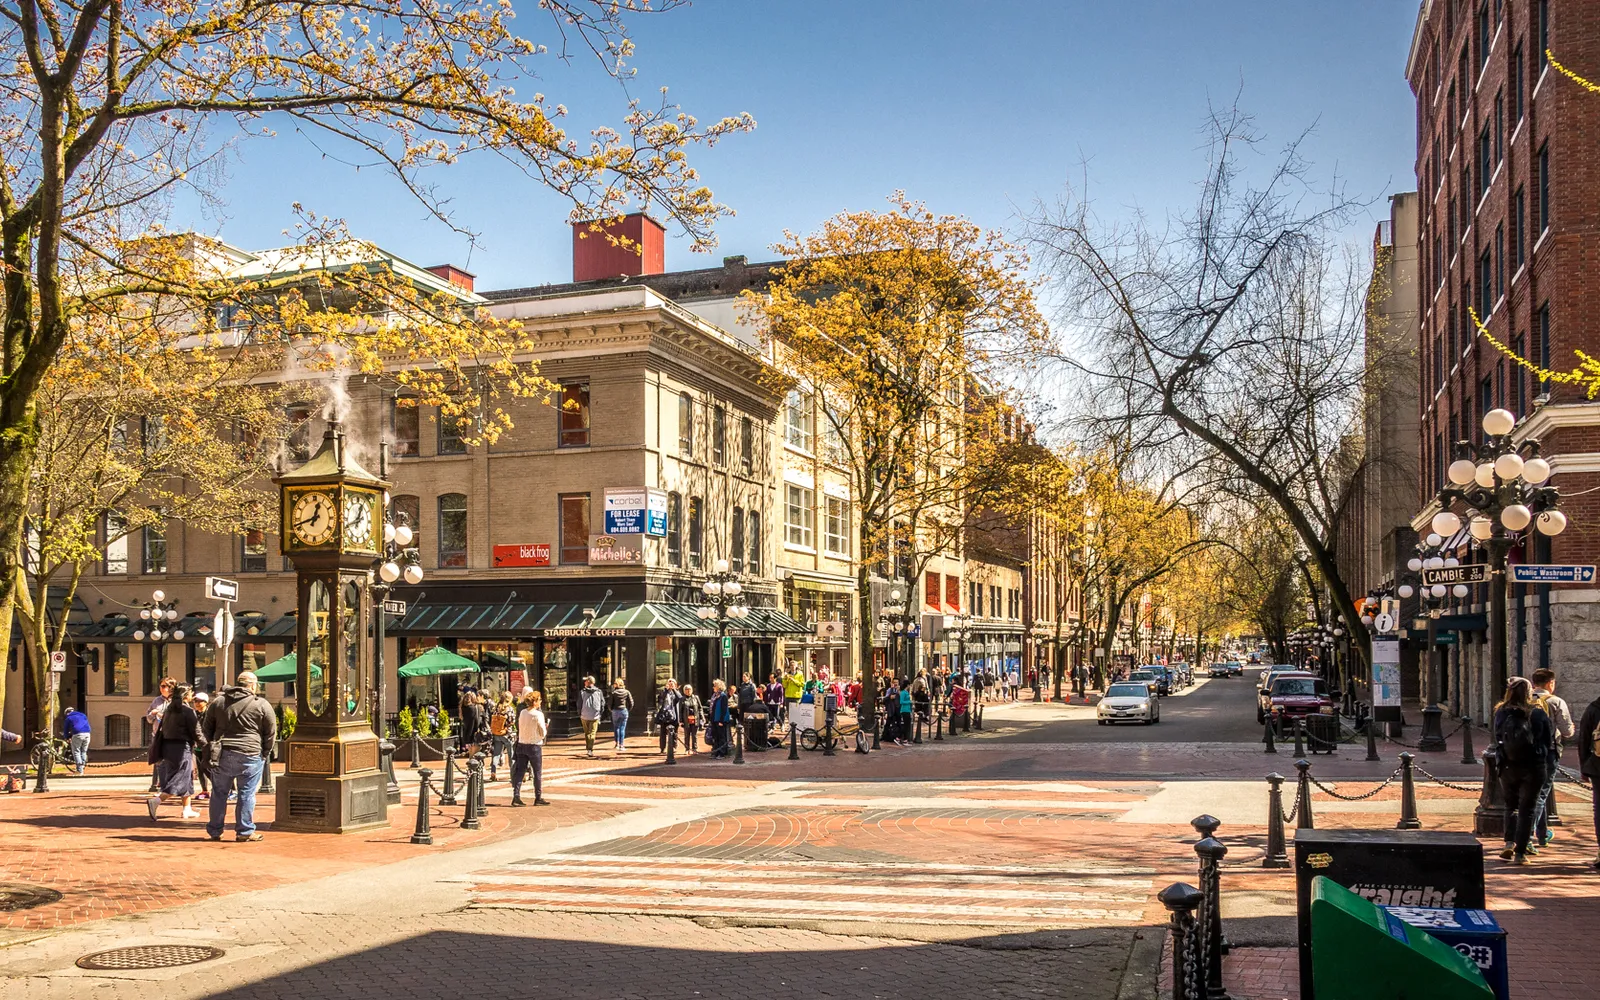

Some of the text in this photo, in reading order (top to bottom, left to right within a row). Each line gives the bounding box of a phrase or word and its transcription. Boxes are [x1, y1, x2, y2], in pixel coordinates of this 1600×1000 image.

[610, 510, 640, 518] FOR LEASE
[520, 546, 550, 560] black frog
[590, 546, 641, 561] Michelle's
[1429, 568, 1465, 583] CAMBIE
[543, 629, 626, 637] STARBUCKS COFFEE
[1348, 885, 1458, 908] traight
